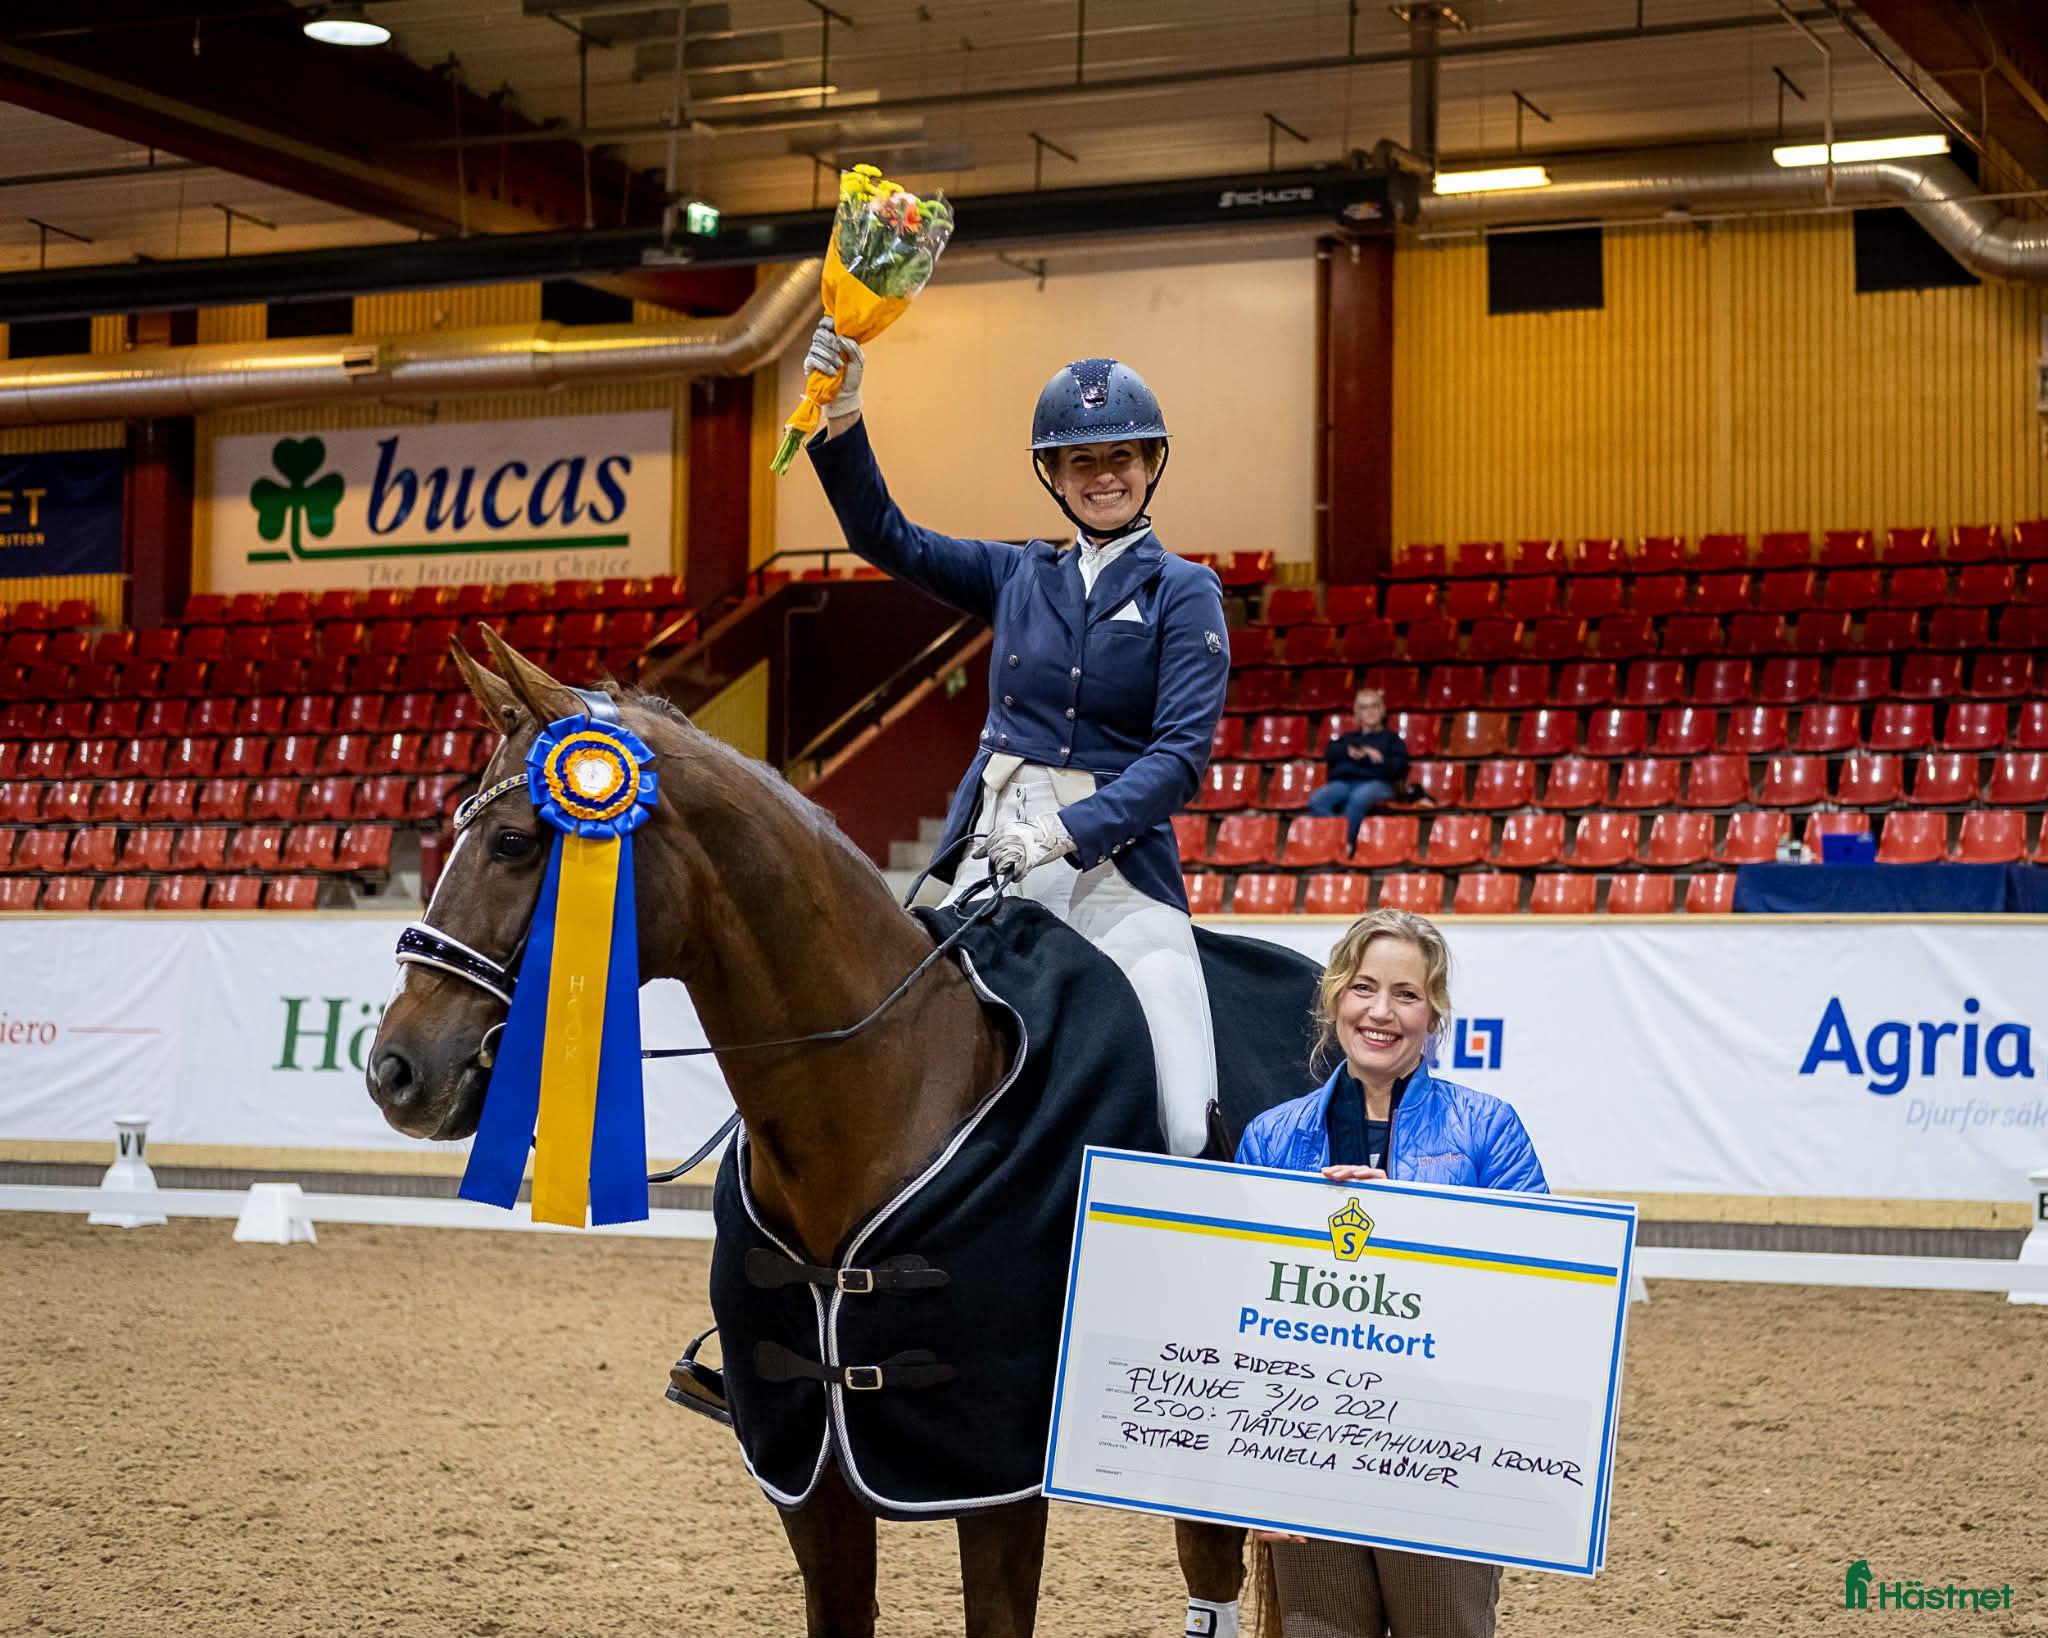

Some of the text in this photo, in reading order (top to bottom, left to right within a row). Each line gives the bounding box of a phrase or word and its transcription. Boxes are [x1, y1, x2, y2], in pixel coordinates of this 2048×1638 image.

[367, 435, 632, 536] bucas
[367, 552, 632, 584] The Intelligent Choice
[1799, 997, 2035, 1096] Agria
[1265, 1261, 1422, 1320] Hööks
[1239, 1307, 1436, 1359] Presentkort
[1160, 1343, 1383, 1391] SWB RIDERS CUP
[1265, 1384, 1319, 1412] 3/10
[1334, 1394, 1399, 1424] 2021
[1121, 1421, 1460, 1489] RYTTARE DANIELLA SCHÖNER
[1226, 1409, 1482, 1463] TVÅTUSENFEMHUNDRA
[1492, 1447, 1584, 1486] KRONOR
